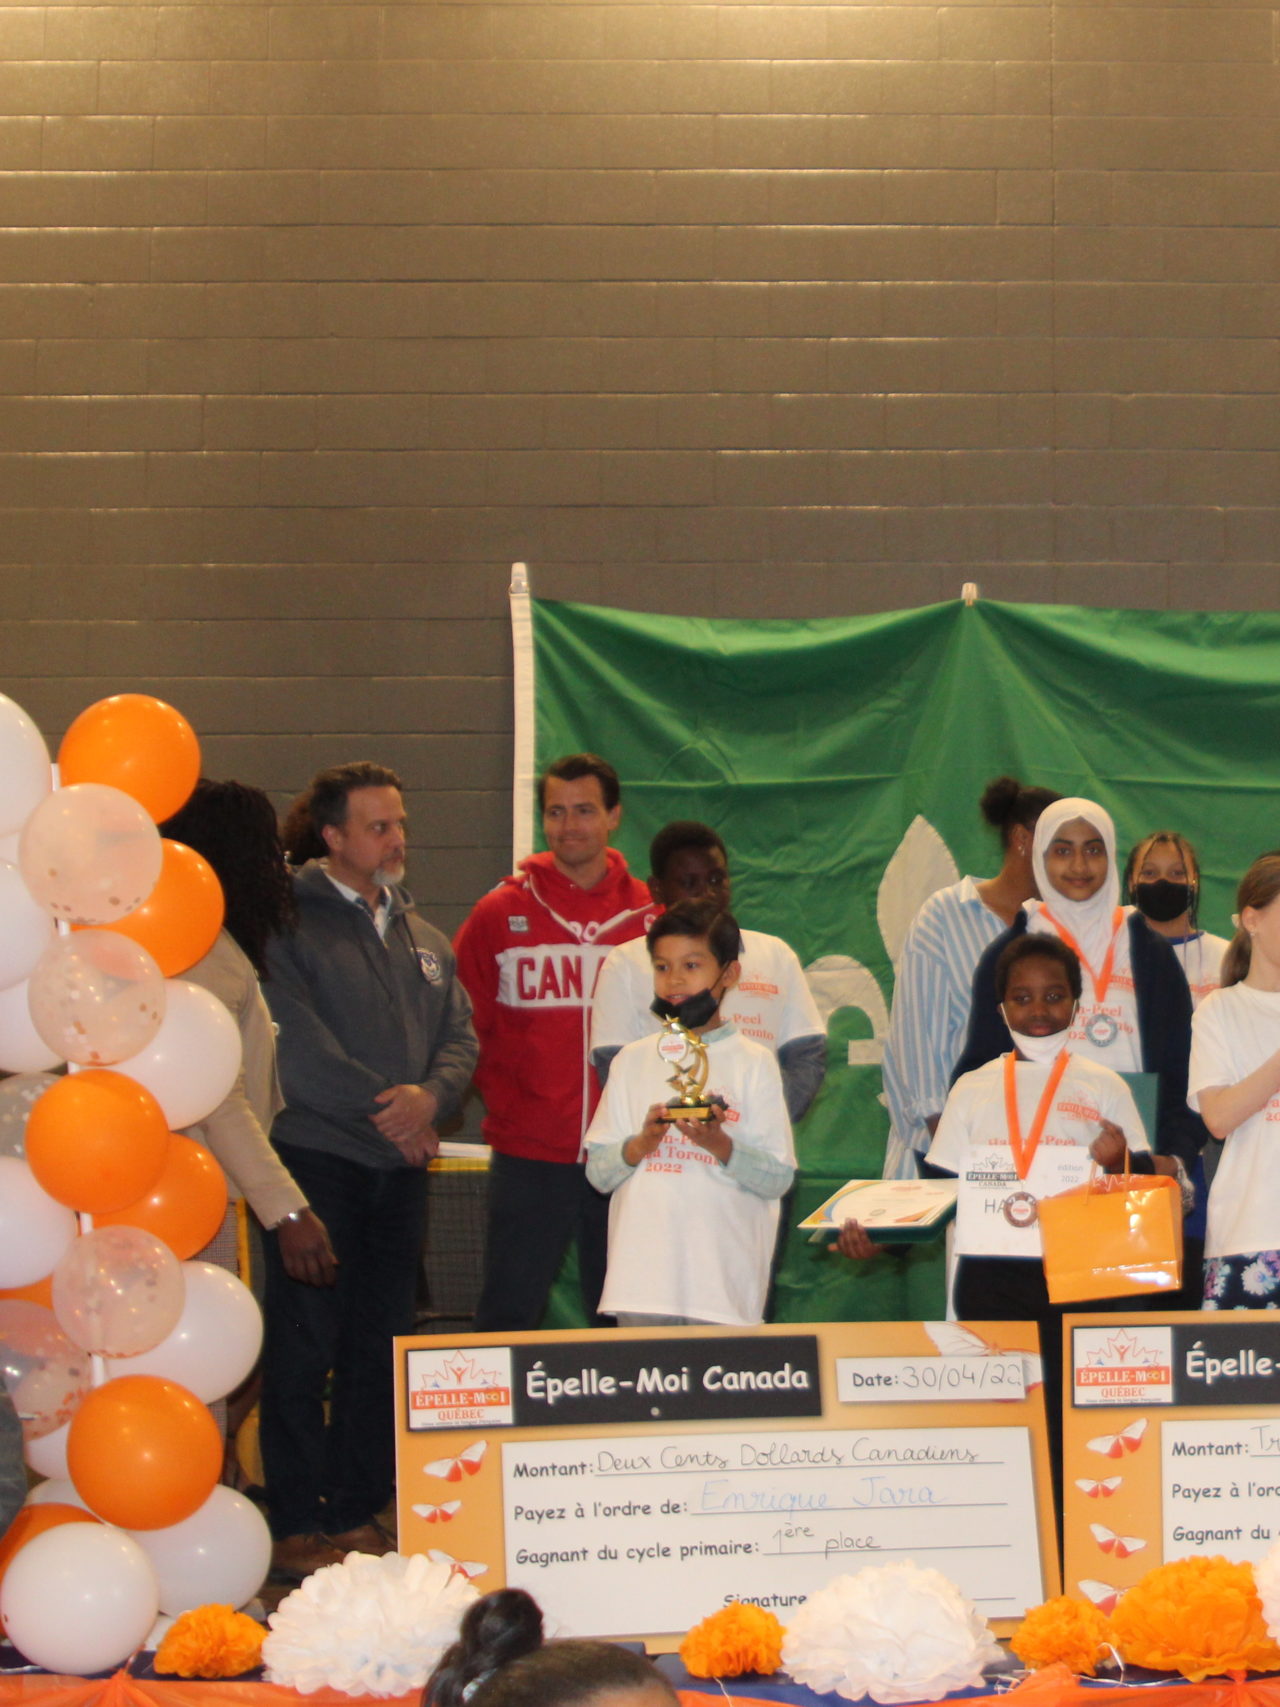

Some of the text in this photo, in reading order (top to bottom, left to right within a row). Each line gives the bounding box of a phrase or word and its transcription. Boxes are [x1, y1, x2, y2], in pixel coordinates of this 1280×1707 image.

[517, 955, 607, 1000] CAN
[666, 1146, 719, 1166] Toron
[645, 1162, 683, 1173] 2022
[526, 1361, 810, 1405] Épelle-Moi Canada
[852, 1371, 899, 1387] Date:
[1101, 1386, 1146, 1398] QUÉBEC
[438, 1408, 485, 1421] QUÉBEC
[513, 1437, 979, 1478] Montant: Deux Cents Dollards Canadiens
[1172, 1441, 1249, 1456] Montant:
[514, 1475, 946, 1524] Payez à l'ordre de: Enrique Jara
[1172, 1484, 1222, 1503] Payez
[1230, 1482, 1240, 1497] à
[1173, 1526, 1243, 1545] Gagnant
[1250, 1525, 1270, 1541] du
[515, 1548, 588, 1567] Gagnant
[597, 1545, 618, 1561] du
[626, 1542, 672, 1565] cycle
[680, 1540, 759, 1560] primaire:
[825, 1532, 881, 1560] place
[723, 1593, 807, 1608] Snature
